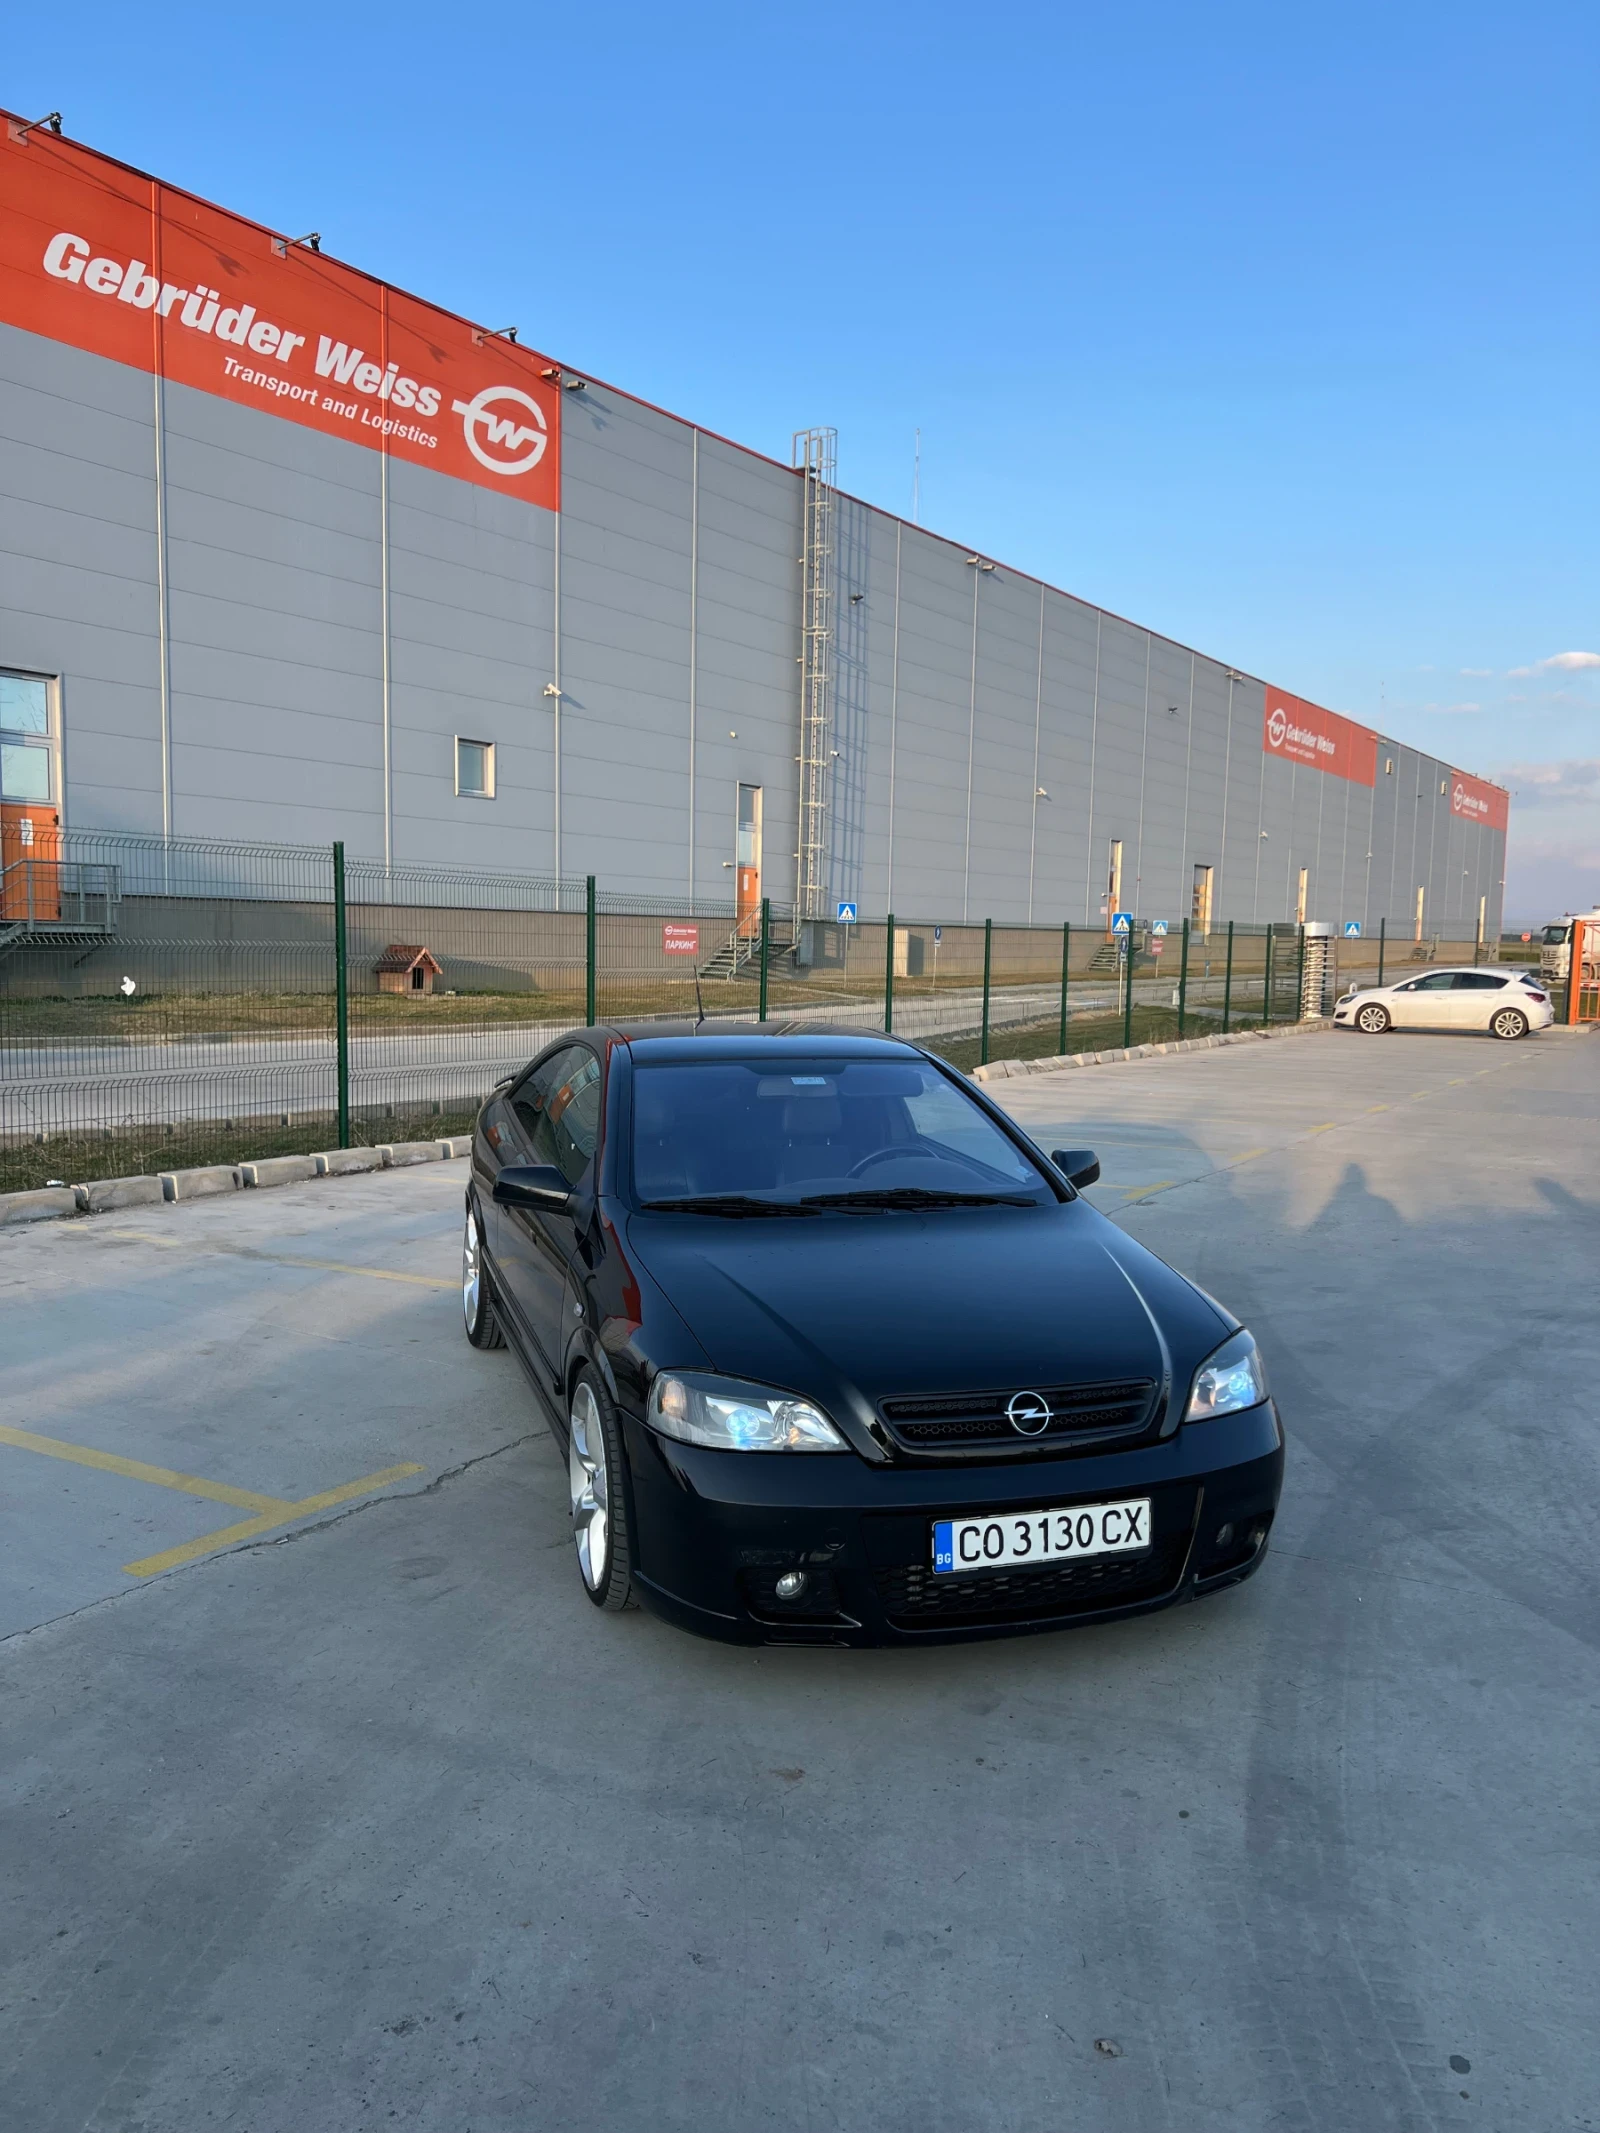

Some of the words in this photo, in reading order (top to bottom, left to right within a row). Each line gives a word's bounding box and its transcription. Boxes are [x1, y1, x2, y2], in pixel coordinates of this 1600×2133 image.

[43, 232, 306, 363] Gebrüder
[314, 334, 442, 417] Weiss
[223, 356, 319, 406] Transport
[321, 395, 359, 420] and
[360, 408, 438, 449] Logistics
[665, 939, 697, 950] ПАРКИНГ
[936, 1553, 951, 1565] BG
